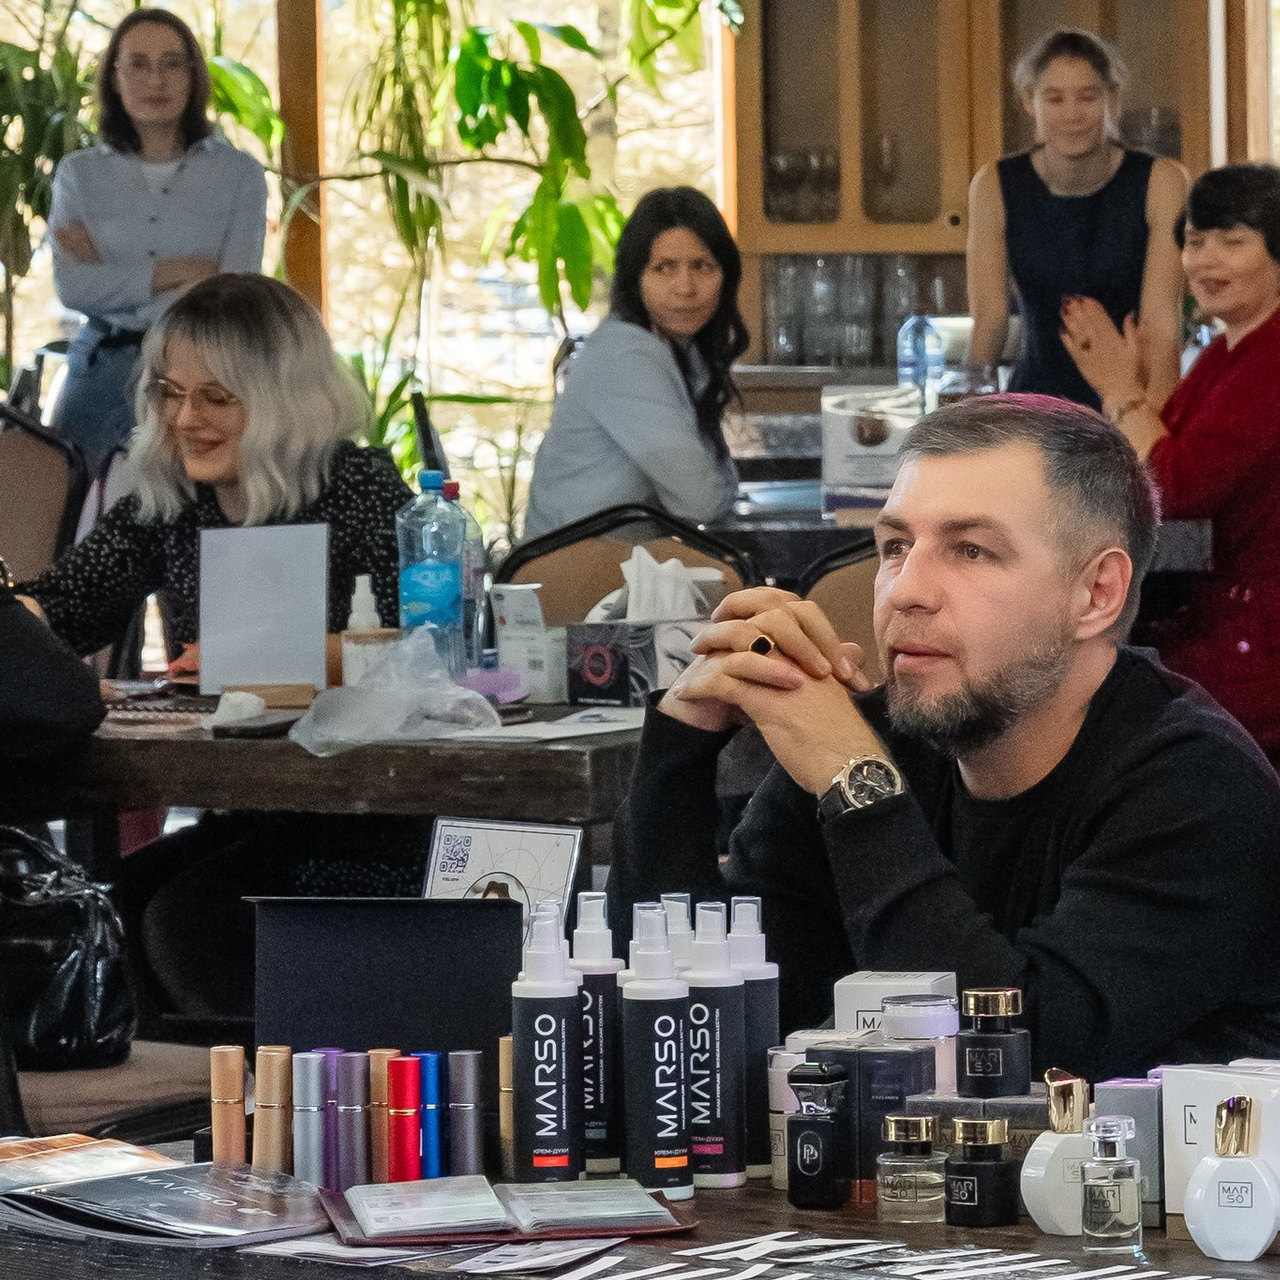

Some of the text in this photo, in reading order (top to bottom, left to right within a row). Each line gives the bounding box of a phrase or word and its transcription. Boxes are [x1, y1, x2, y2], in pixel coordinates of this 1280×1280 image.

[690, 1003, 711, 1124] MARSO
[534, 1014, 558, 1137] MARSO
[654, 1015, 678, 1137] MARSO
[130, 1175, 238, 1207] MARSO
[890, 1189, 908, 1198] SO
[1221, 1185, 1249, 1195] MAR
[952, 1191, 968, 1200] SO
[1227, 1195, 1245, 1204] SO
[1091, 1200, 1111, 1209] SO
